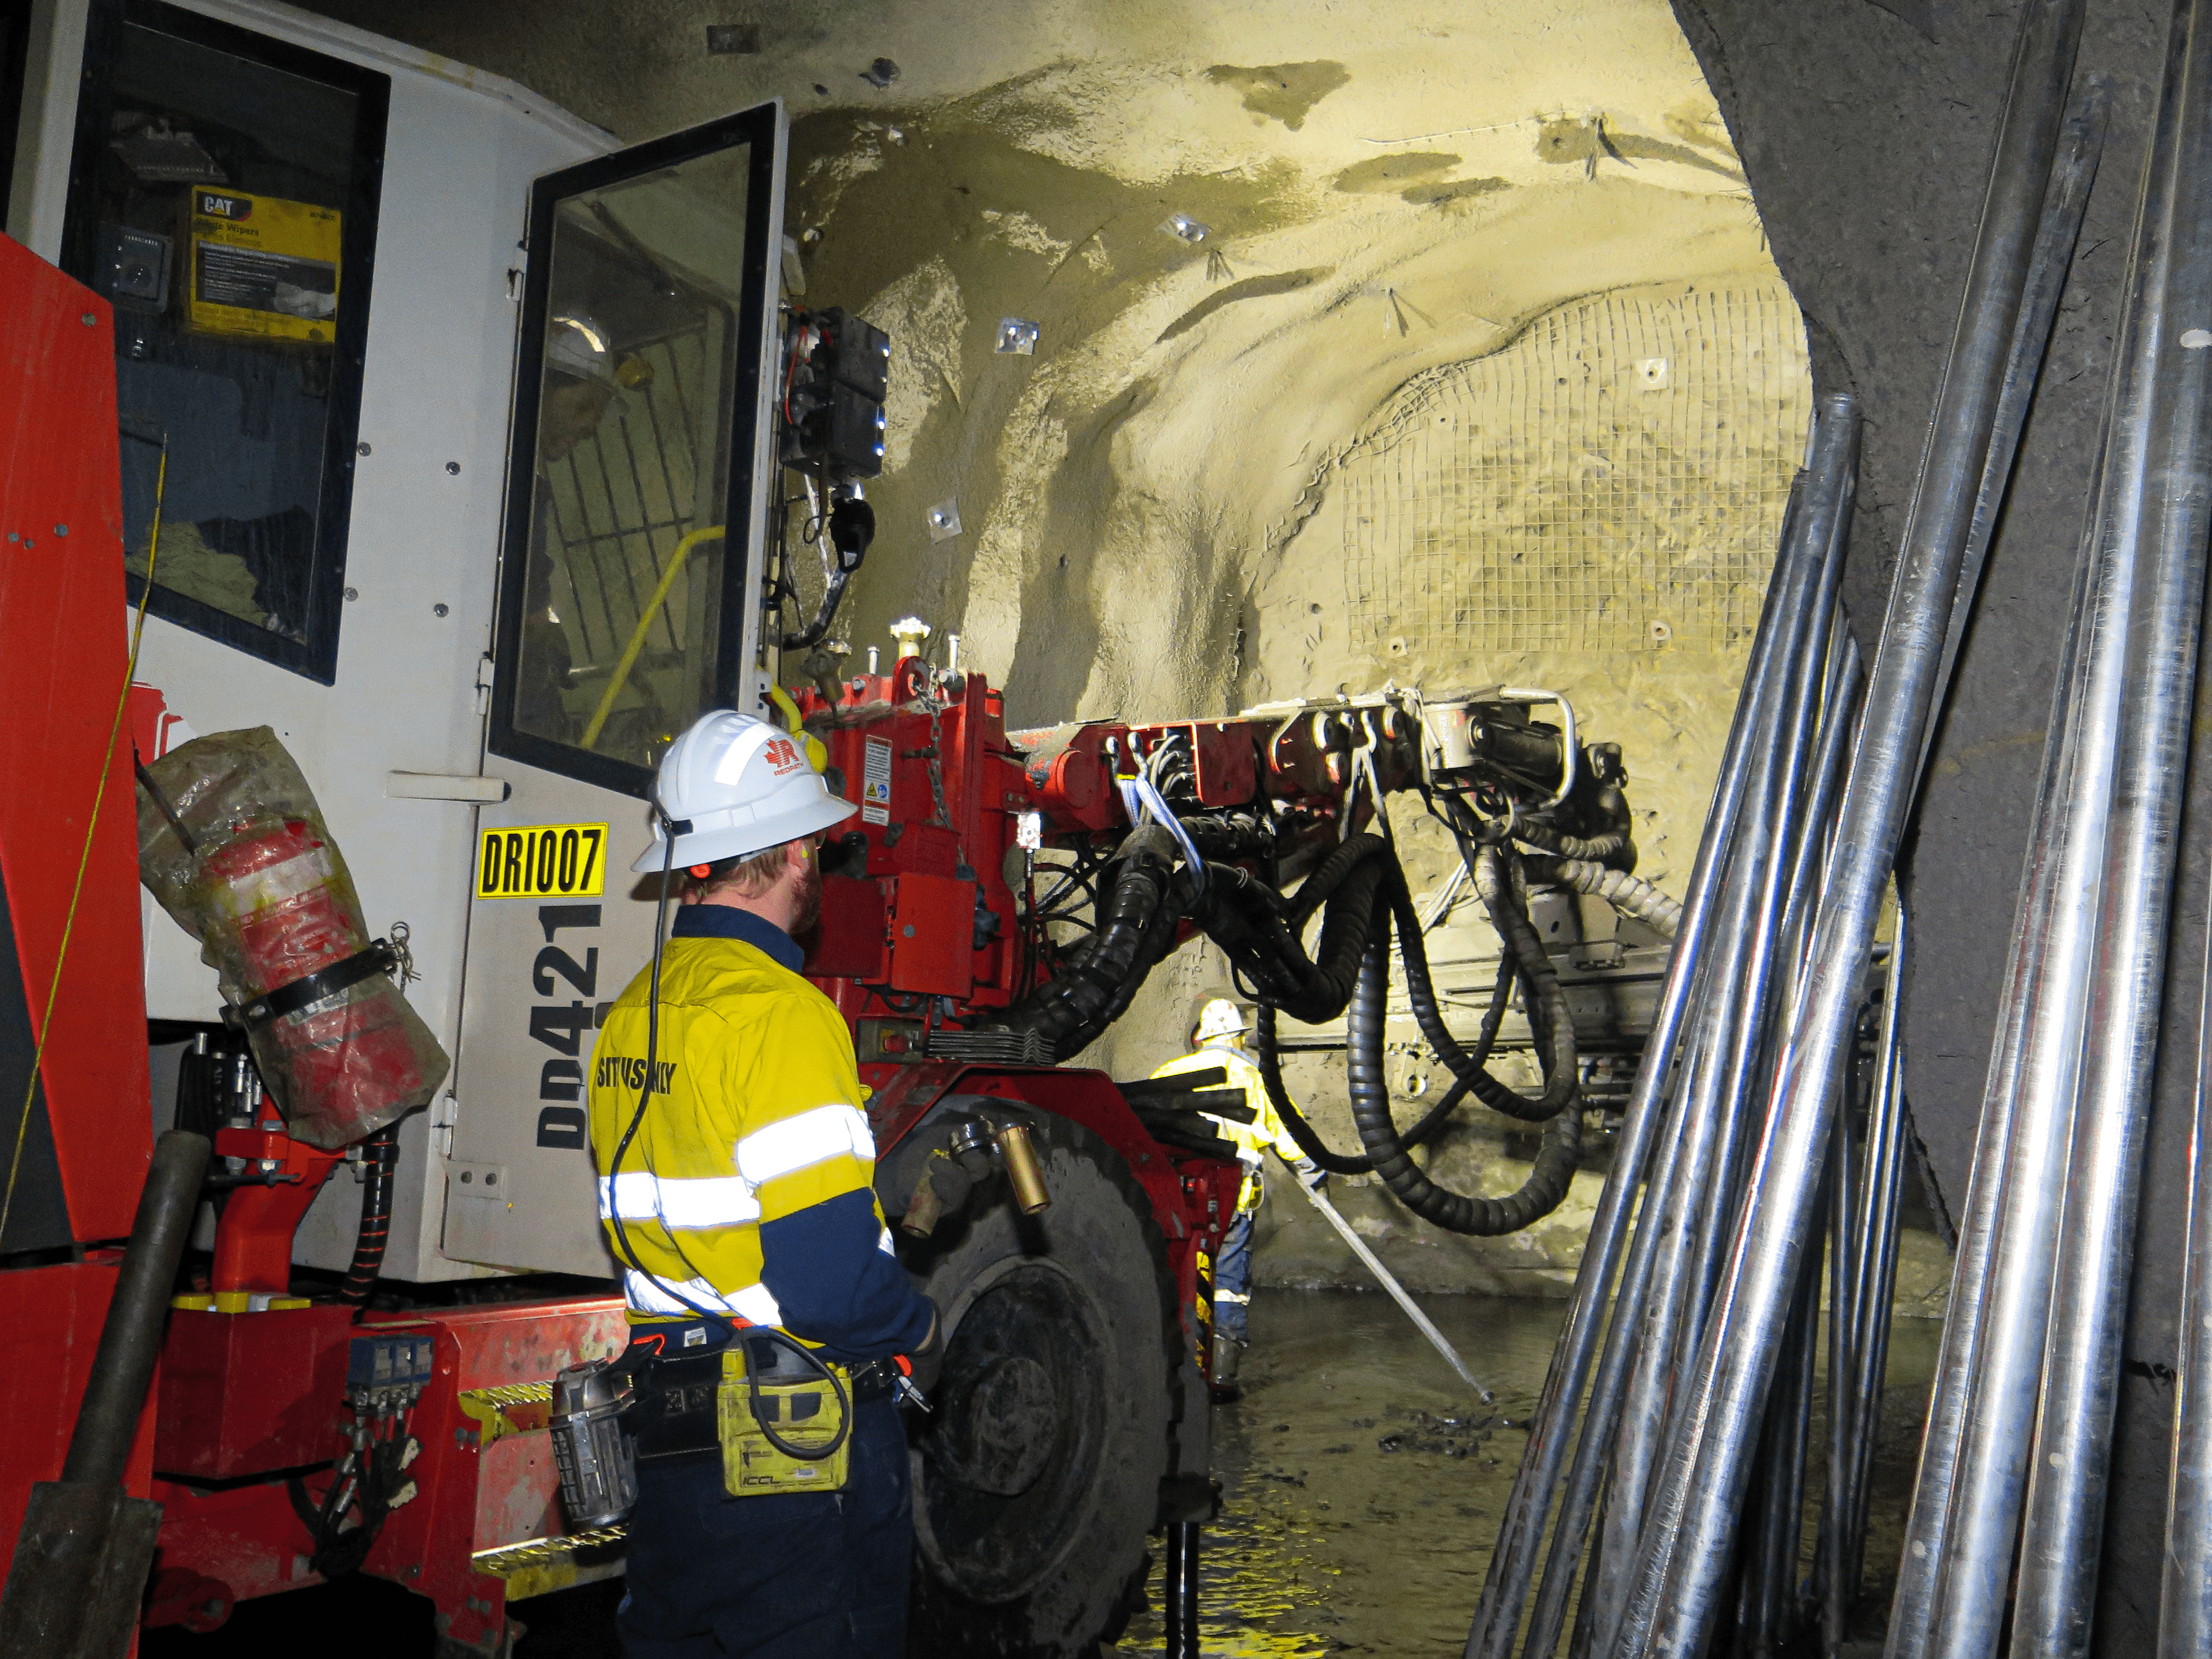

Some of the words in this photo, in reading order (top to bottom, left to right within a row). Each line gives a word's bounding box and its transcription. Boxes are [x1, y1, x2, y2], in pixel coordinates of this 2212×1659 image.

[205, 196, 233, 216] CAT
[774, 763, 804, 776] REDPATH
[529, 904, 602, 1151] DD421
